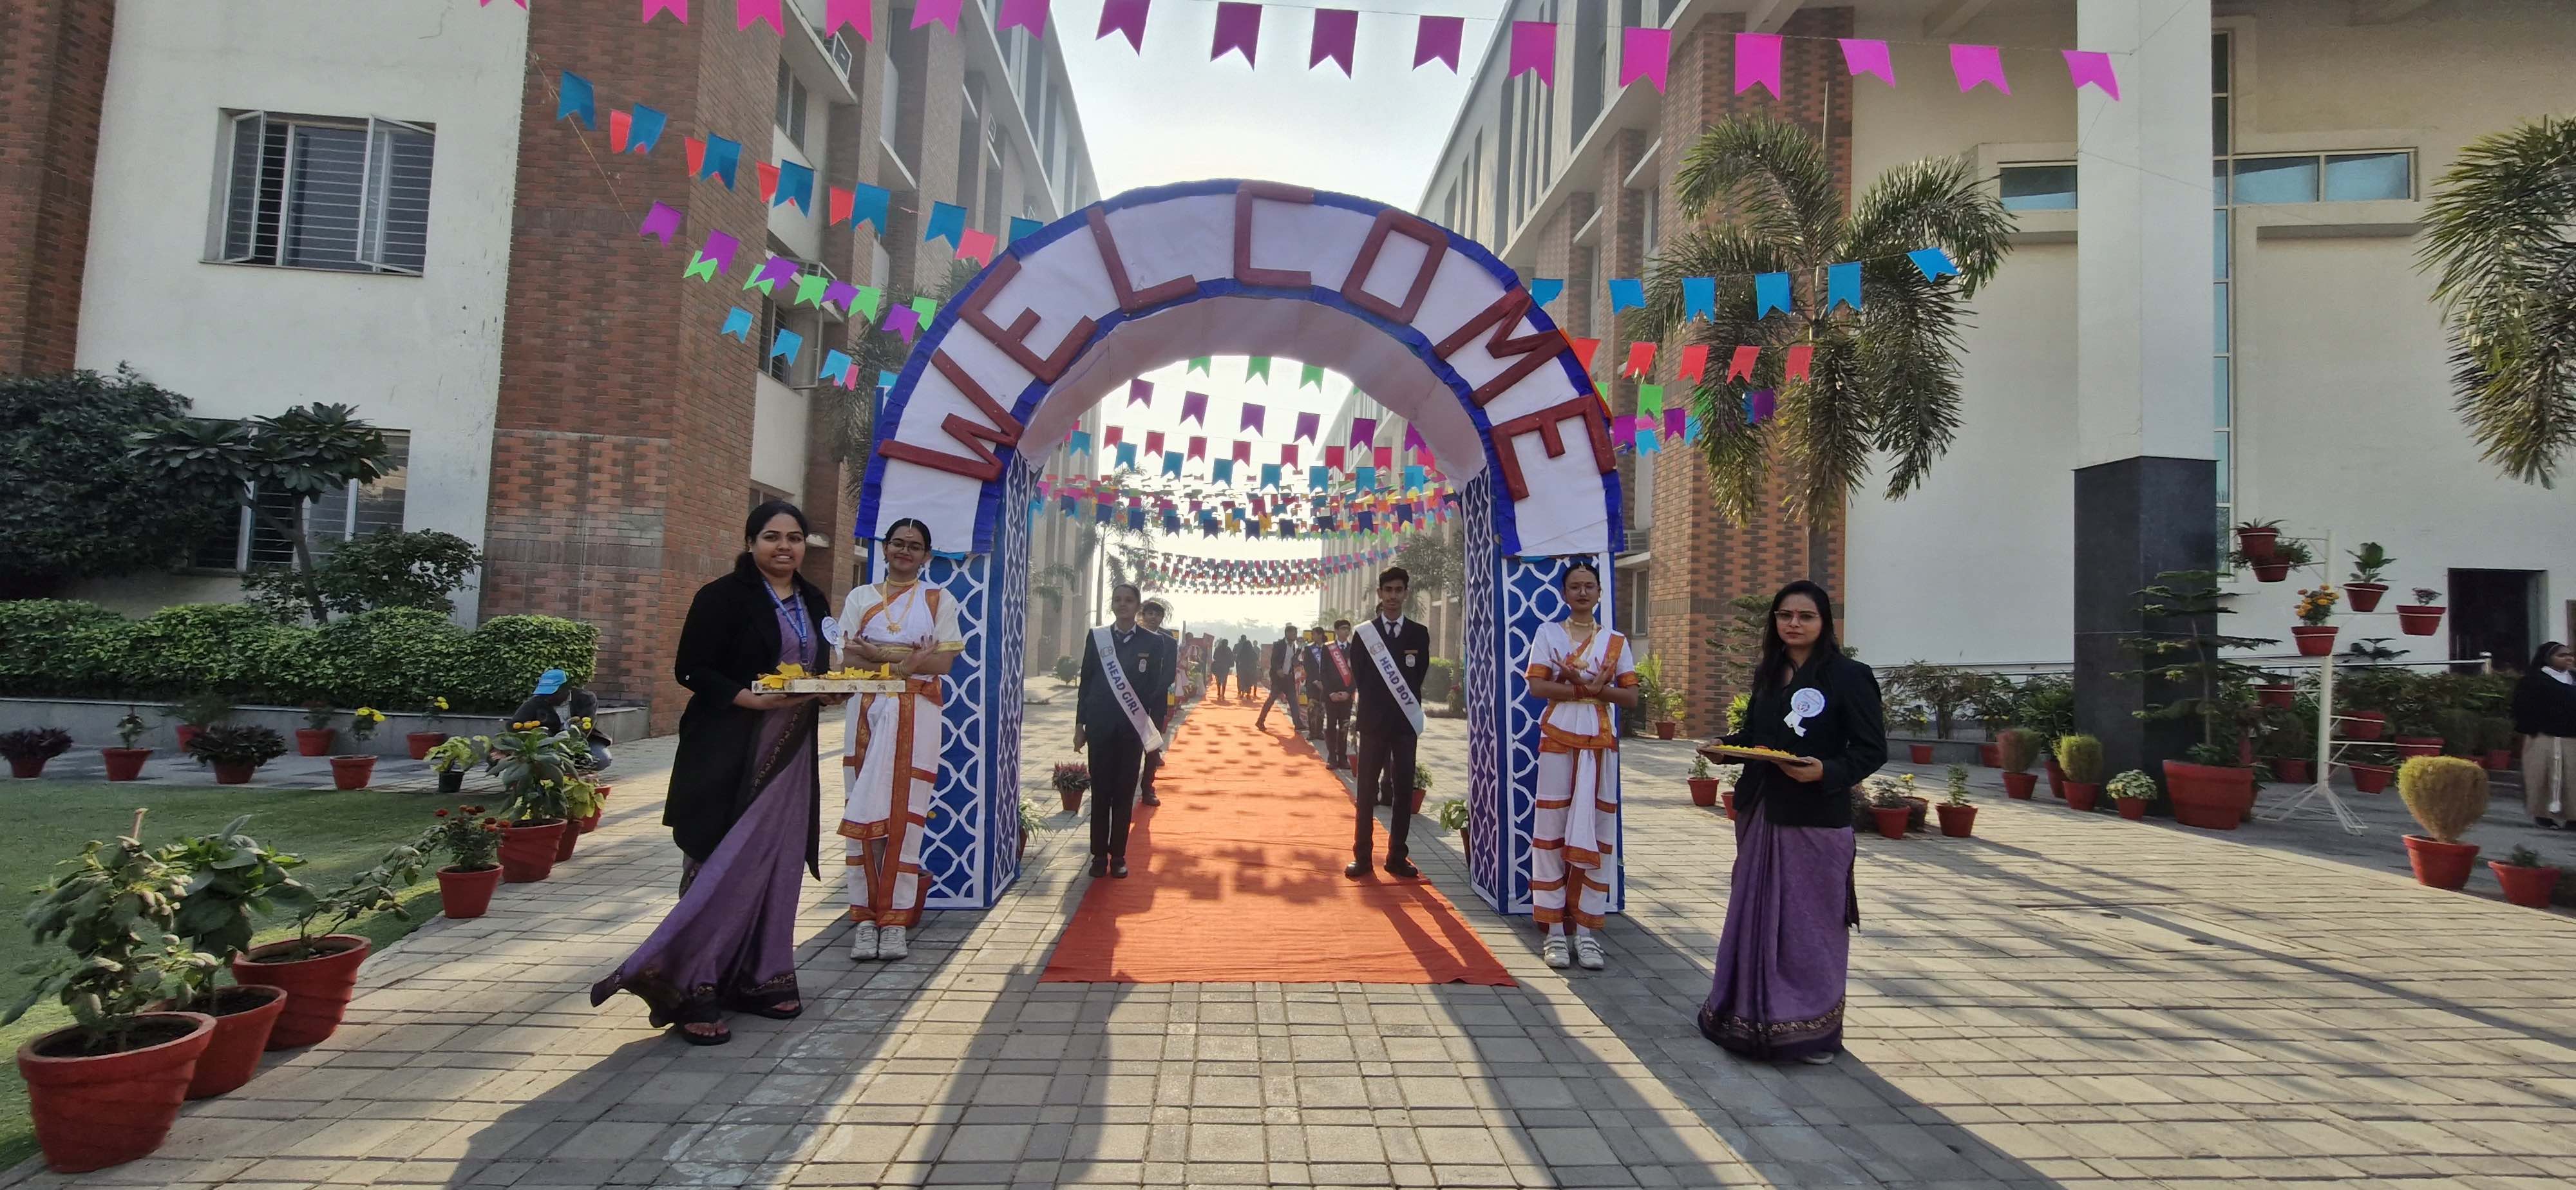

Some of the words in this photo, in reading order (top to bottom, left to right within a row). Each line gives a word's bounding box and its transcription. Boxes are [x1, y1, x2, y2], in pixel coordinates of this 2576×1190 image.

[878, 180, 1617, 502] WELCOME
[1106, 660, 1126, 690] HEAD
[1122, 692, 1140, 715] GIRL
[1333, 650, 1349, 675] CAPT
[1379, 656, 1399, 685] HEAD
[1396, 685, 1414, 706] BOY
